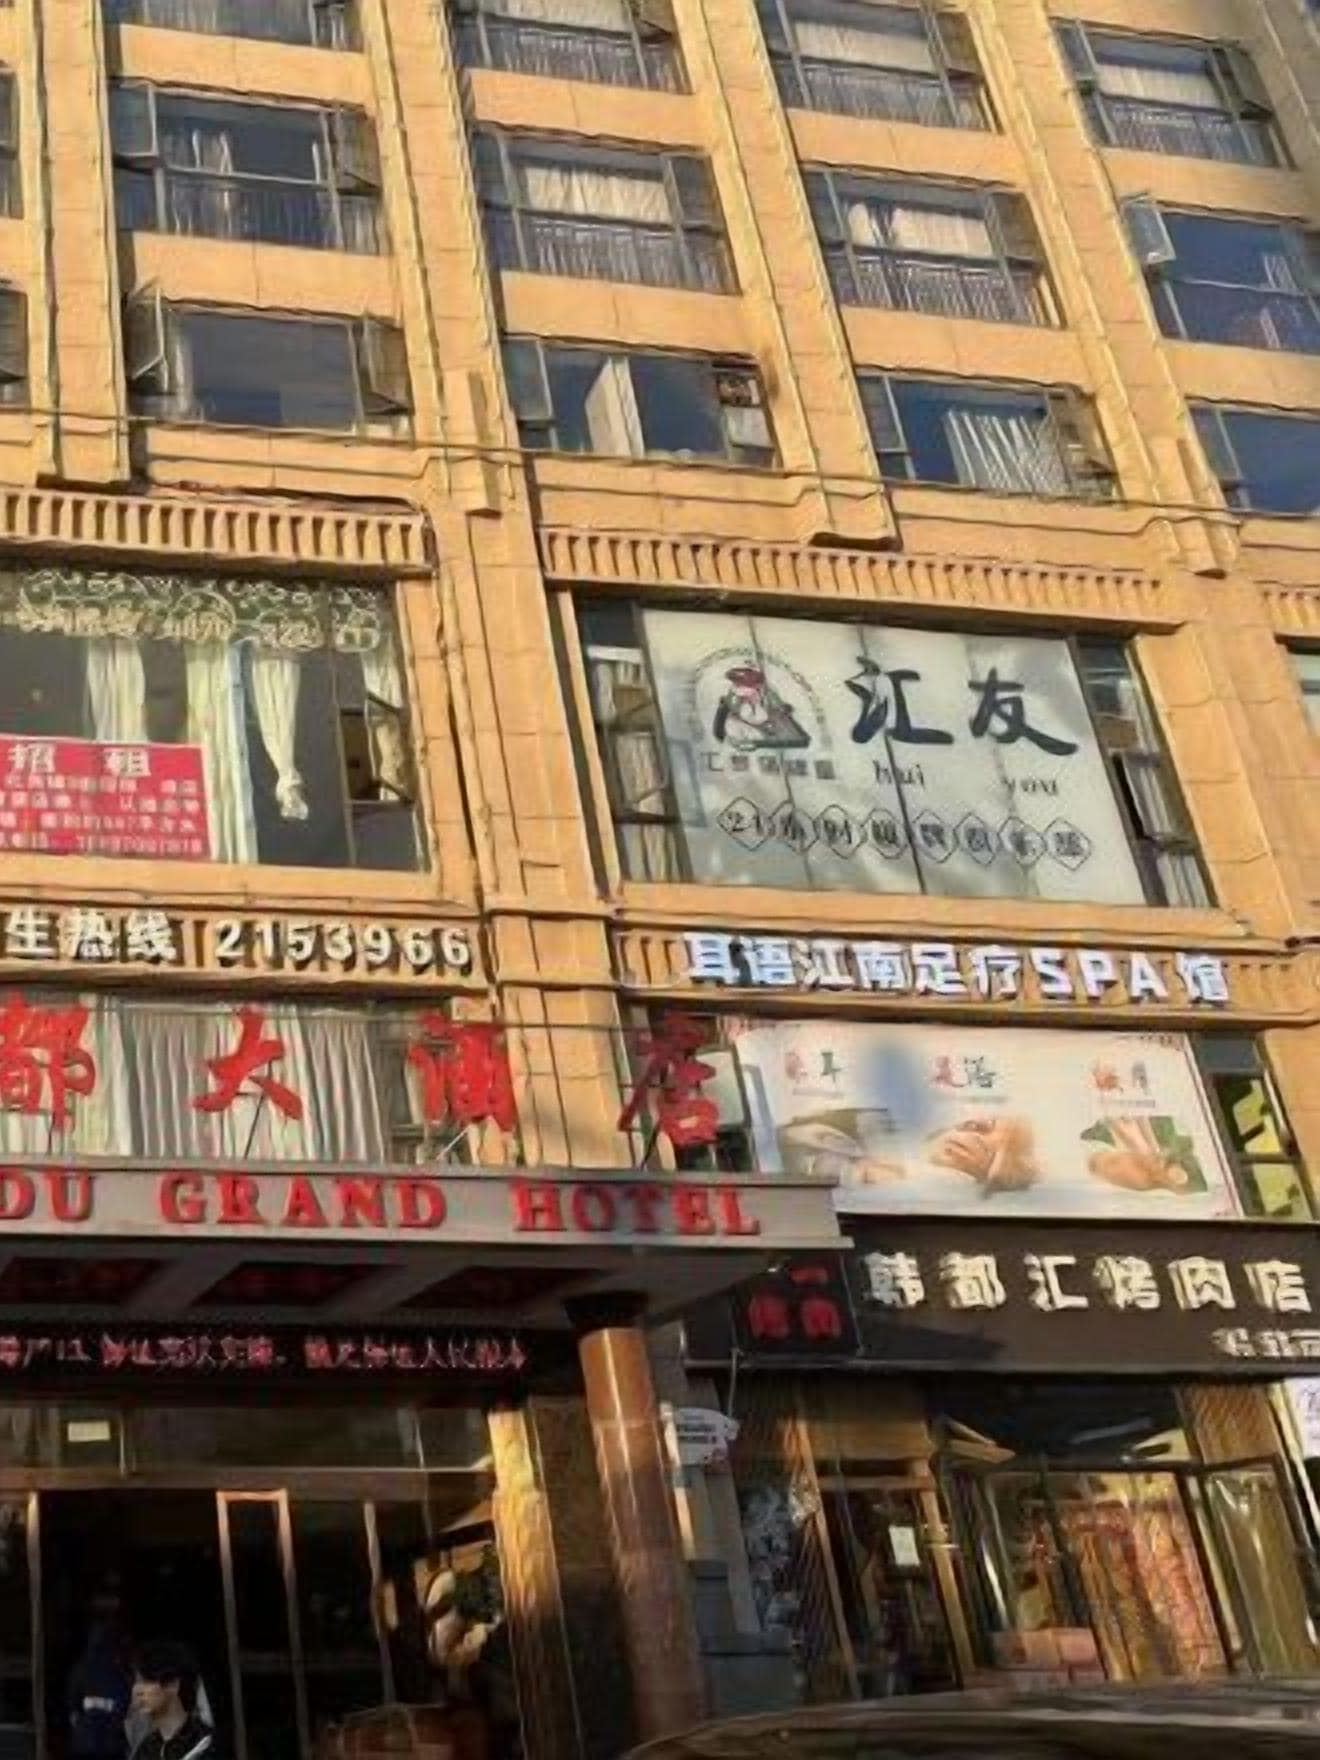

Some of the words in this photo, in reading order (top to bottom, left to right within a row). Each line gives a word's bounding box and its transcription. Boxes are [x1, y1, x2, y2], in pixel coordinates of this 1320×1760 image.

[844, 655, 1080, 757] 汇友
[214, 918, 472, 968] 2153966
[159, 1170, 449, 1229] GRAND
[510, 1178, 764, 1237] HOTEL
